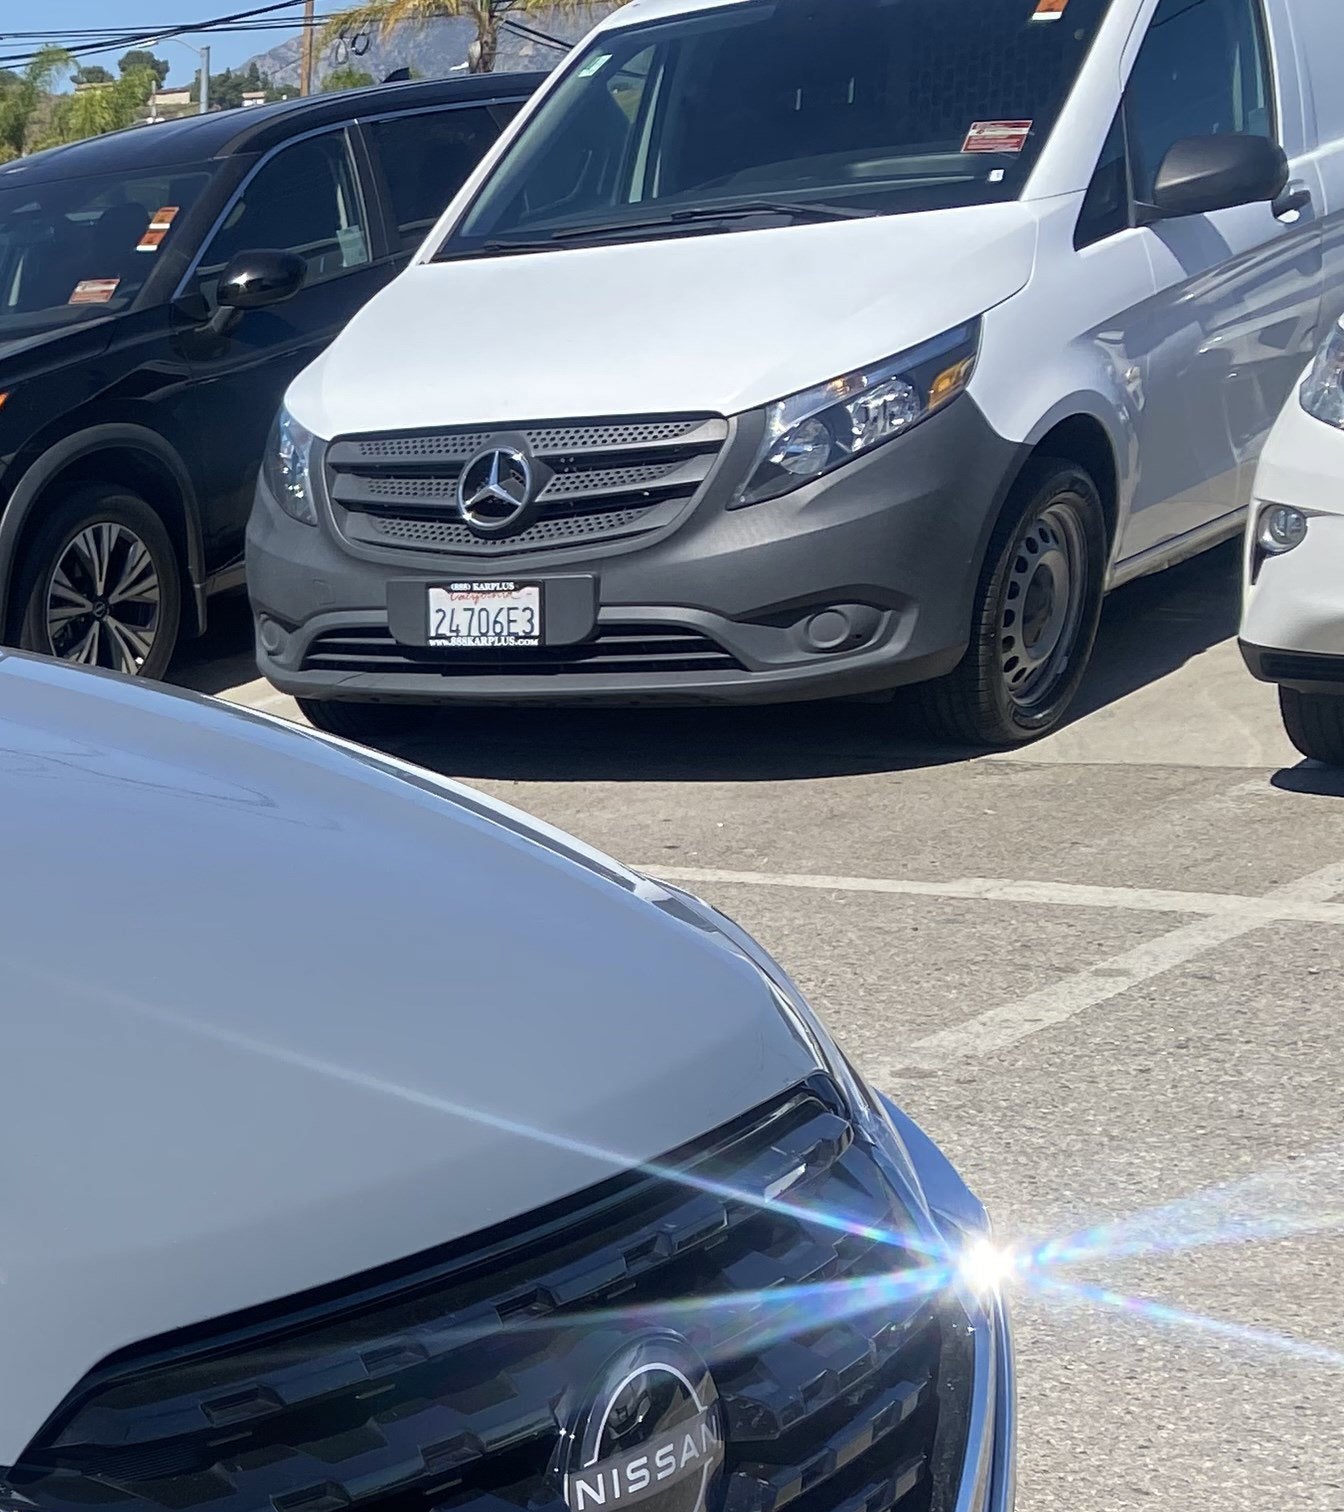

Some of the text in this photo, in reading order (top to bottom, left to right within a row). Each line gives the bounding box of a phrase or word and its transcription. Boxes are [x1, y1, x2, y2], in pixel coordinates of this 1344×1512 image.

[472, 582, 515, 591] KARPLUS
[435, 606, 536, 637] 24706E3
[575, 1414, 723, 1511] NISSAN
